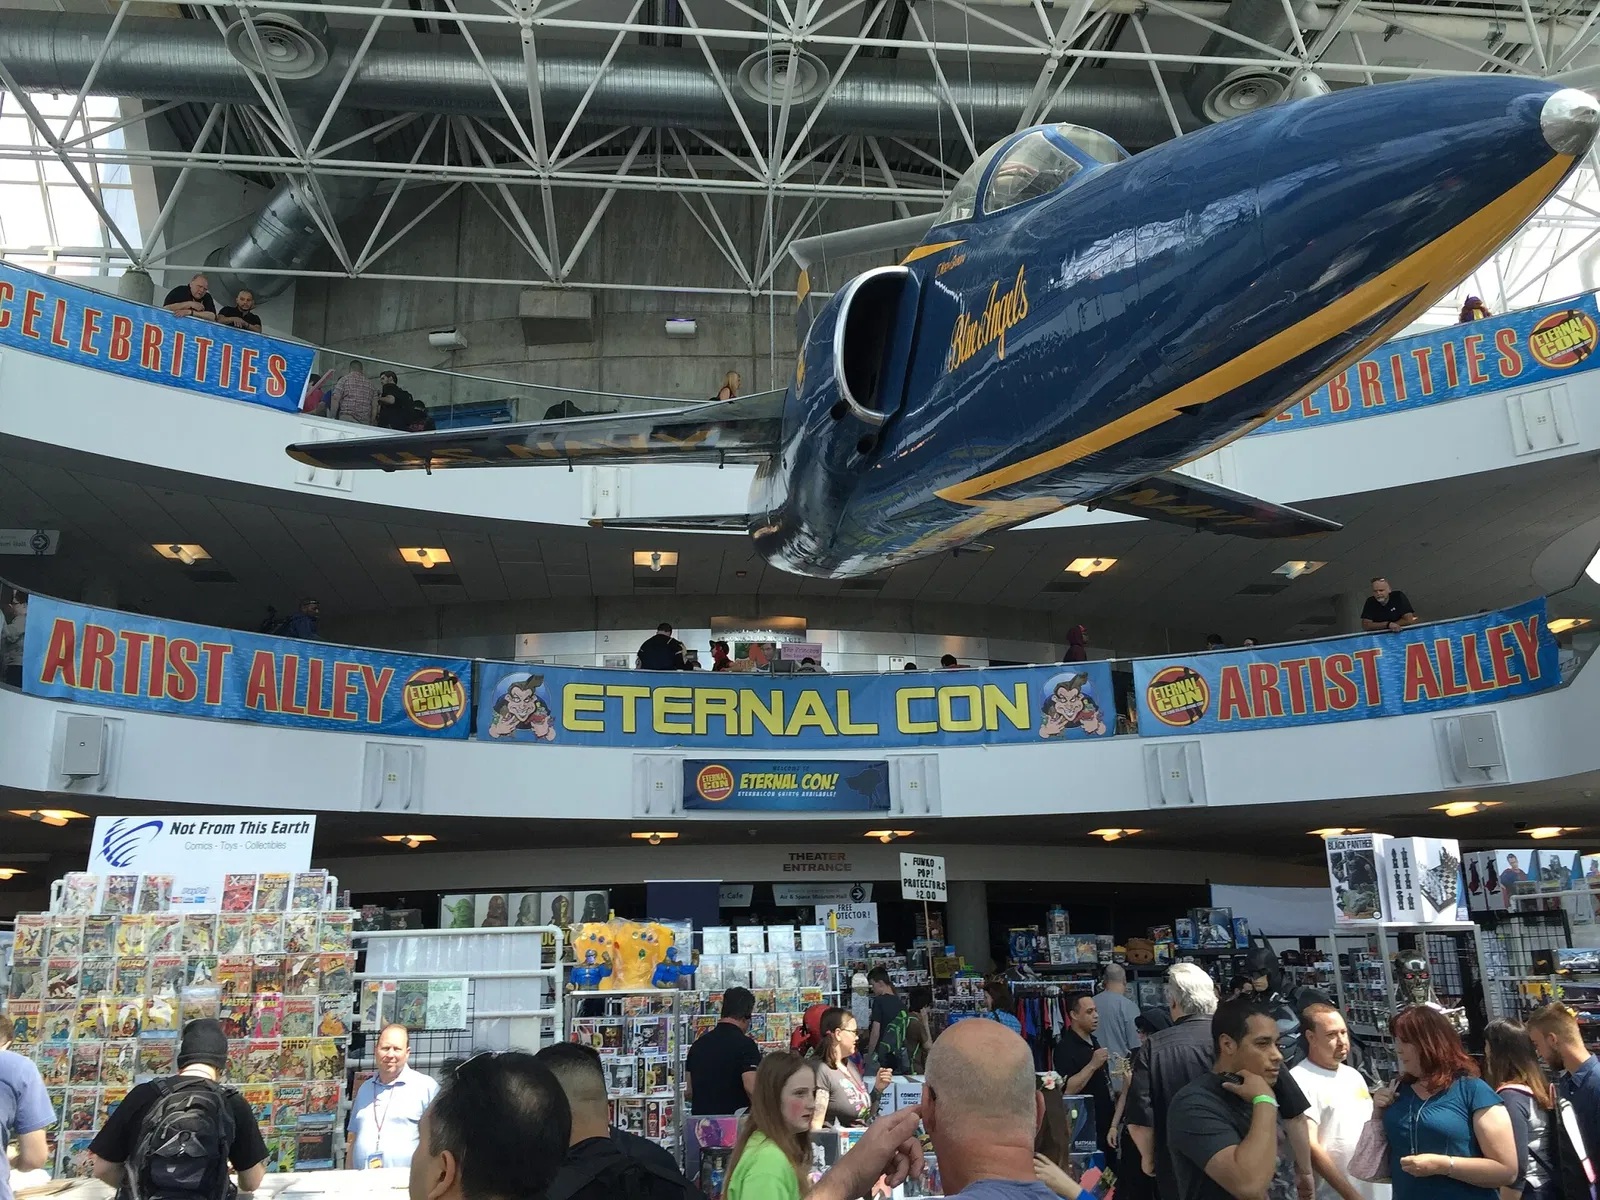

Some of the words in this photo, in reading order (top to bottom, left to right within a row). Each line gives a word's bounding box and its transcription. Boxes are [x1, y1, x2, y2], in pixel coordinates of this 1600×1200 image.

[948, 312, 983, 373] Blue
[981, 264, 1028, 360] Angels
[1535, 317, 1583, 347] ETERNAL
[0, 281, 287, 398] CELEBRITIES
[1540, 325, 1591, 357] CON
[604, 635, 610, 643] 2
[40, 618, 232, 705] ARTIST
[246, 650, 395, 723] ALLEY
[1218, 648, 1383, 721] ARTIST
[1404, 615, 1540, 703] ALLEY
[410, 680, 457, 699] ETERNAL
[1153, 677, 1200, 700] ETERNAL
[412, 692, 459, 712] CON
[1156, 688, 1204, 712] CON
[562, 683, 879, 736] ETERNAL
[895, 682, 1032, 735] CON
[702, 772, 728, 782] ETERNAL
[740, 773, 798, 789] ETERNAL
[801, 773, 840, 790] CON!
[704, 780, 728, 790] CON
[170, 822, 196, 835] Not
[199, 821, 235, 835] From
[239, 821, 268, 834] This
[271, 820, 310, 834] Earth
[185, 841, 213, 850] Comics
[220, 840, 238, 851] Toys
[245, 840, 287, 850] Collectibles
[1328, 841, 1346, 850] BLACK
[1346, 840, 1372, 849] PANTHER
[789, 853, 846, 861] THEATER
[913, 857, 934, 867] FUNKO
[783, 863, 852, 872] ENTRANCE
[917, 869, 934, 878] POP!
[903, 878, 945, 890] PROTECTORS
[916, 890, 936, 900] $2.00
[827, 911, 870, 919] POTECTOR!
[281, 1040, 311, 1049] CINDY
